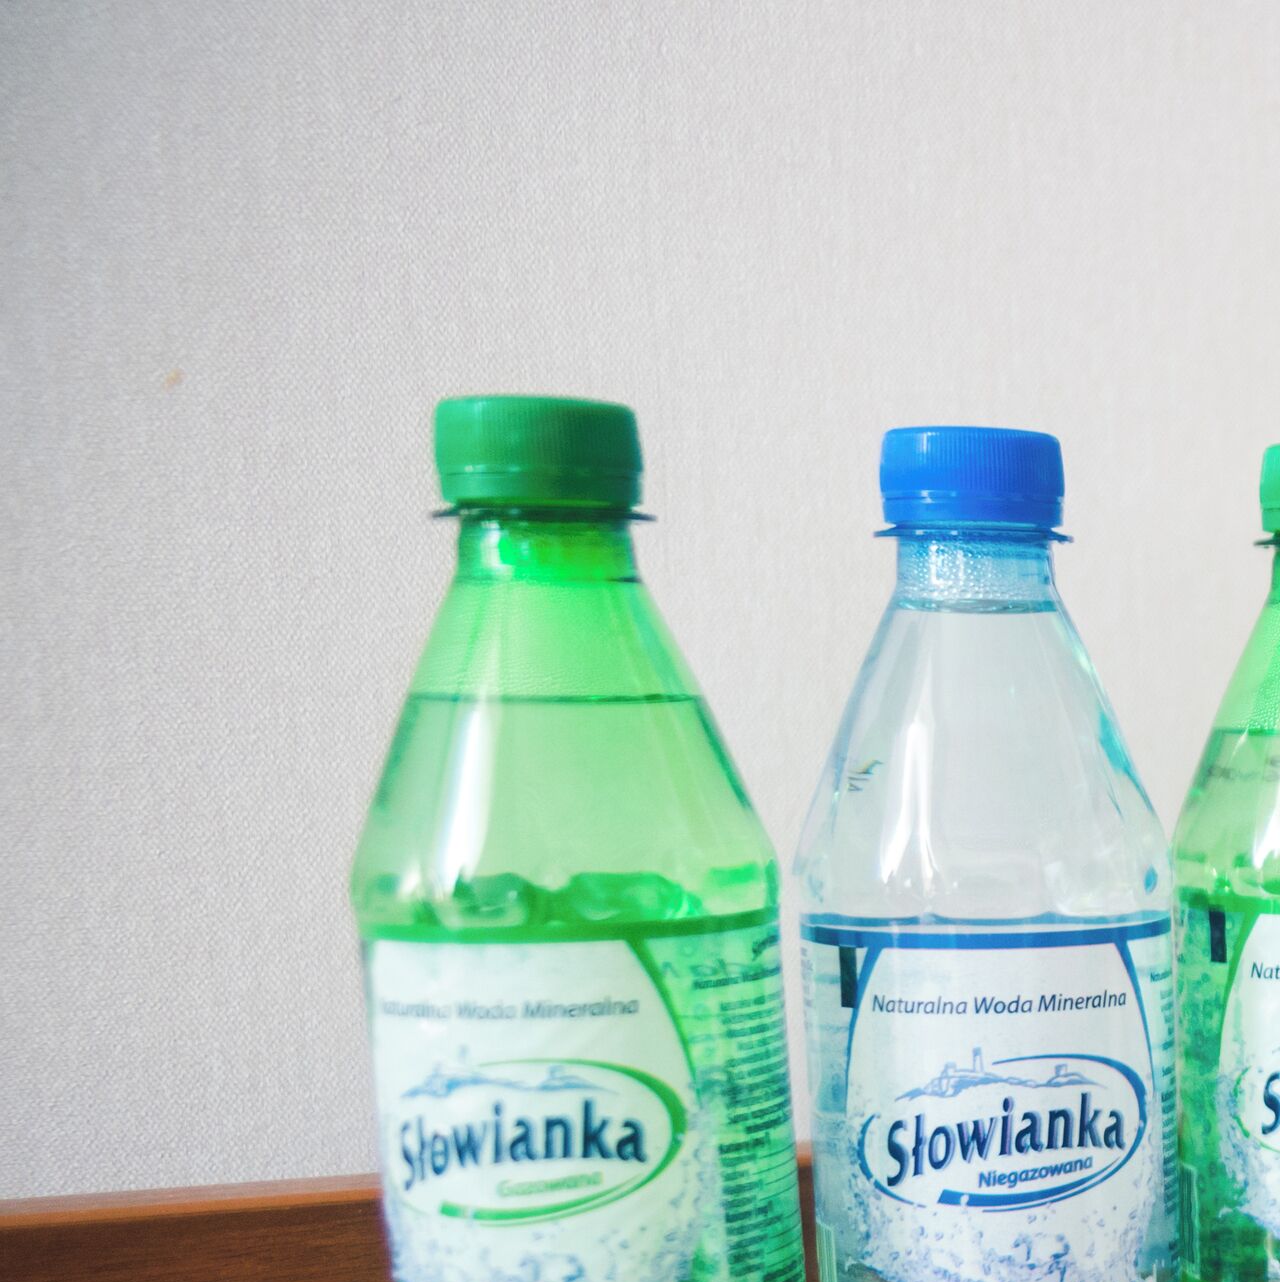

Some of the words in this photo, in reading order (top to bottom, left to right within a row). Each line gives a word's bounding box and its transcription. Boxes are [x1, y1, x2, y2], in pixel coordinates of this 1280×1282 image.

[872, 994, 967, 1015] Naturalna
[974, 995, 1032, 1014] Woda
[1037, 989, 1127, 1013] Mineralna
[401, 1097, 647, 1191] Słowianka
[886, 1091, 1127, 1187] Słowianka
[978, 1155, 1093, 1189] Niegazowana
